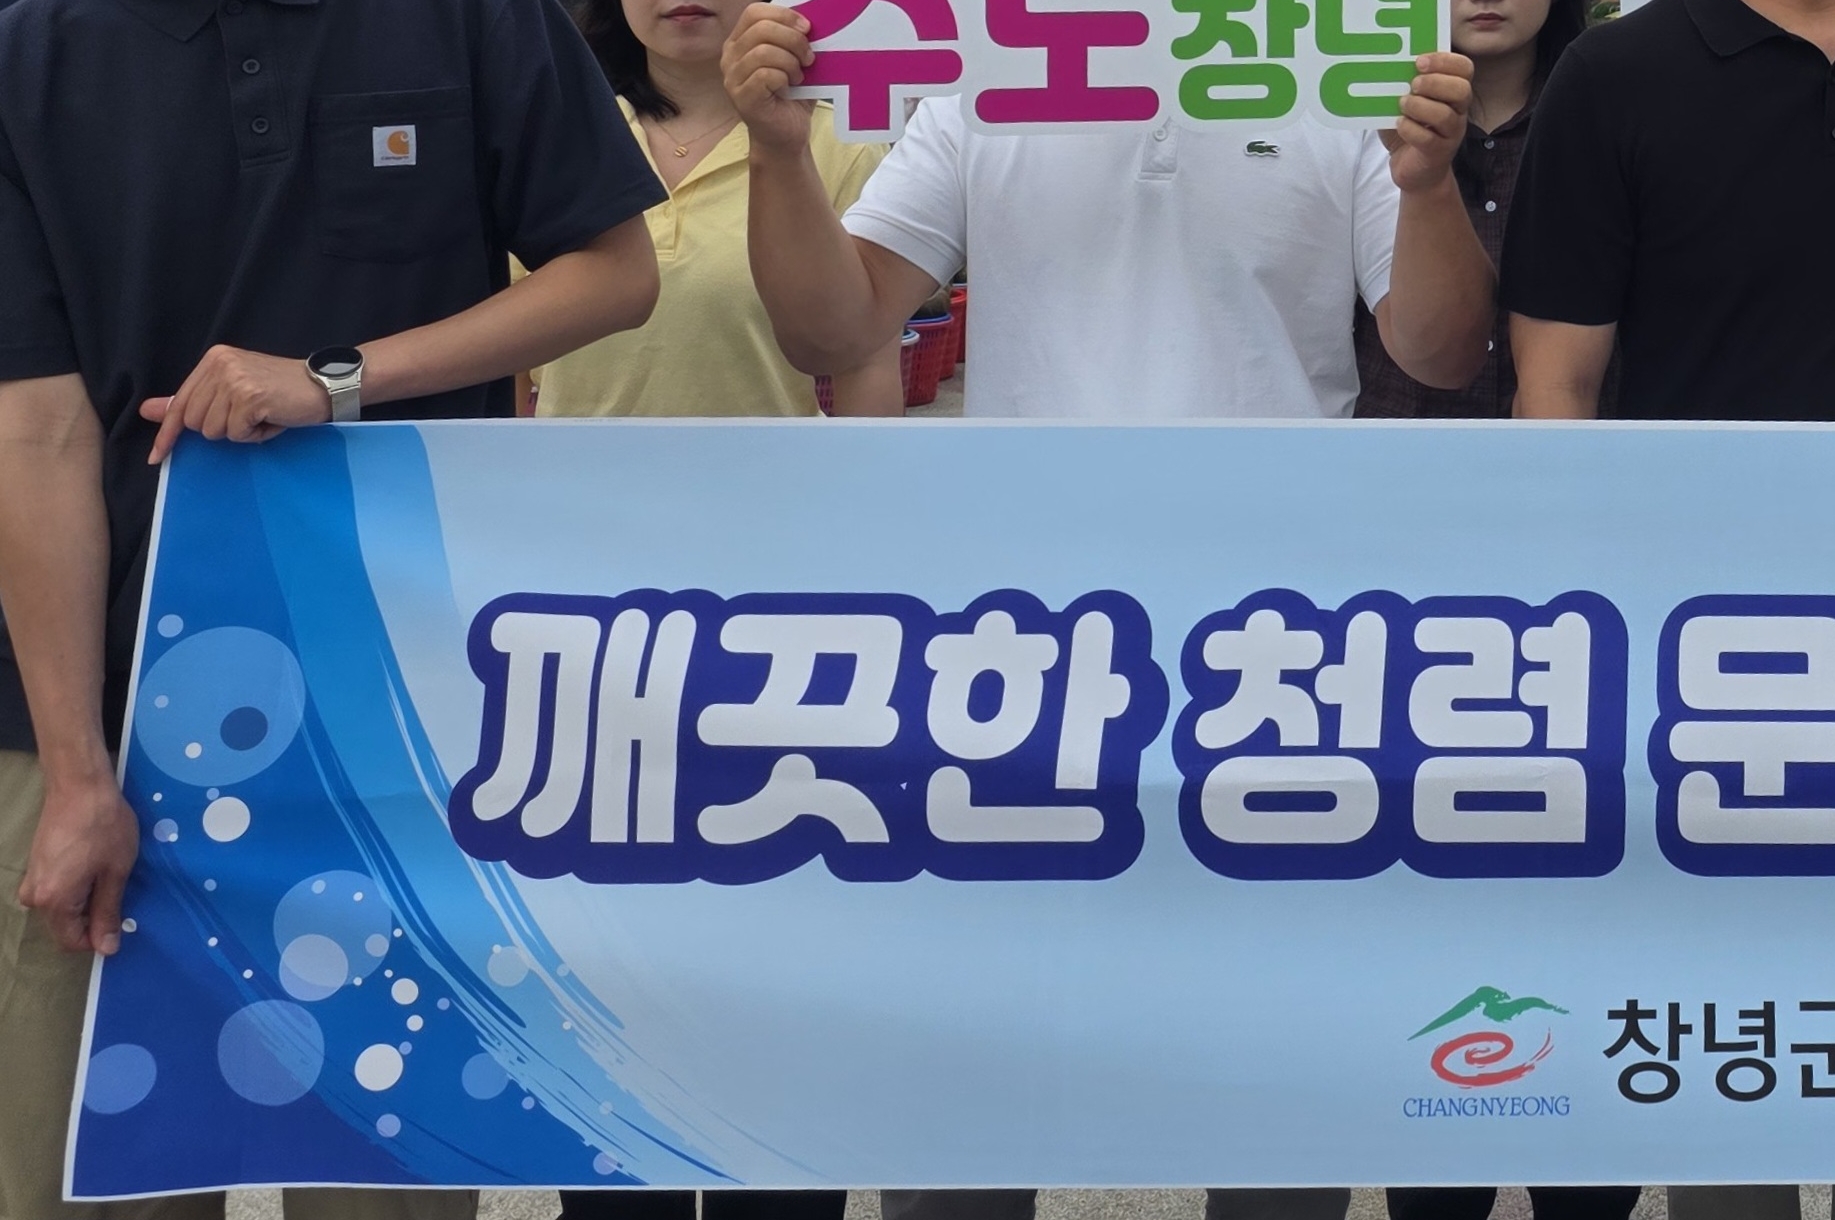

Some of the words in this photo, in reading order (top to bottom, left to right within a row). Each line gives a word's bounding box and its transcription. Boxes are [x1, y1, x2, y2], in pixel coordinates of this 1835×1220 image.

[472, 609, 1131, 843] 깨끗한
[1195, 609, 1591, 844] 청렴
[1403, 1095, 1570, 1118] CHANGNYEONG
